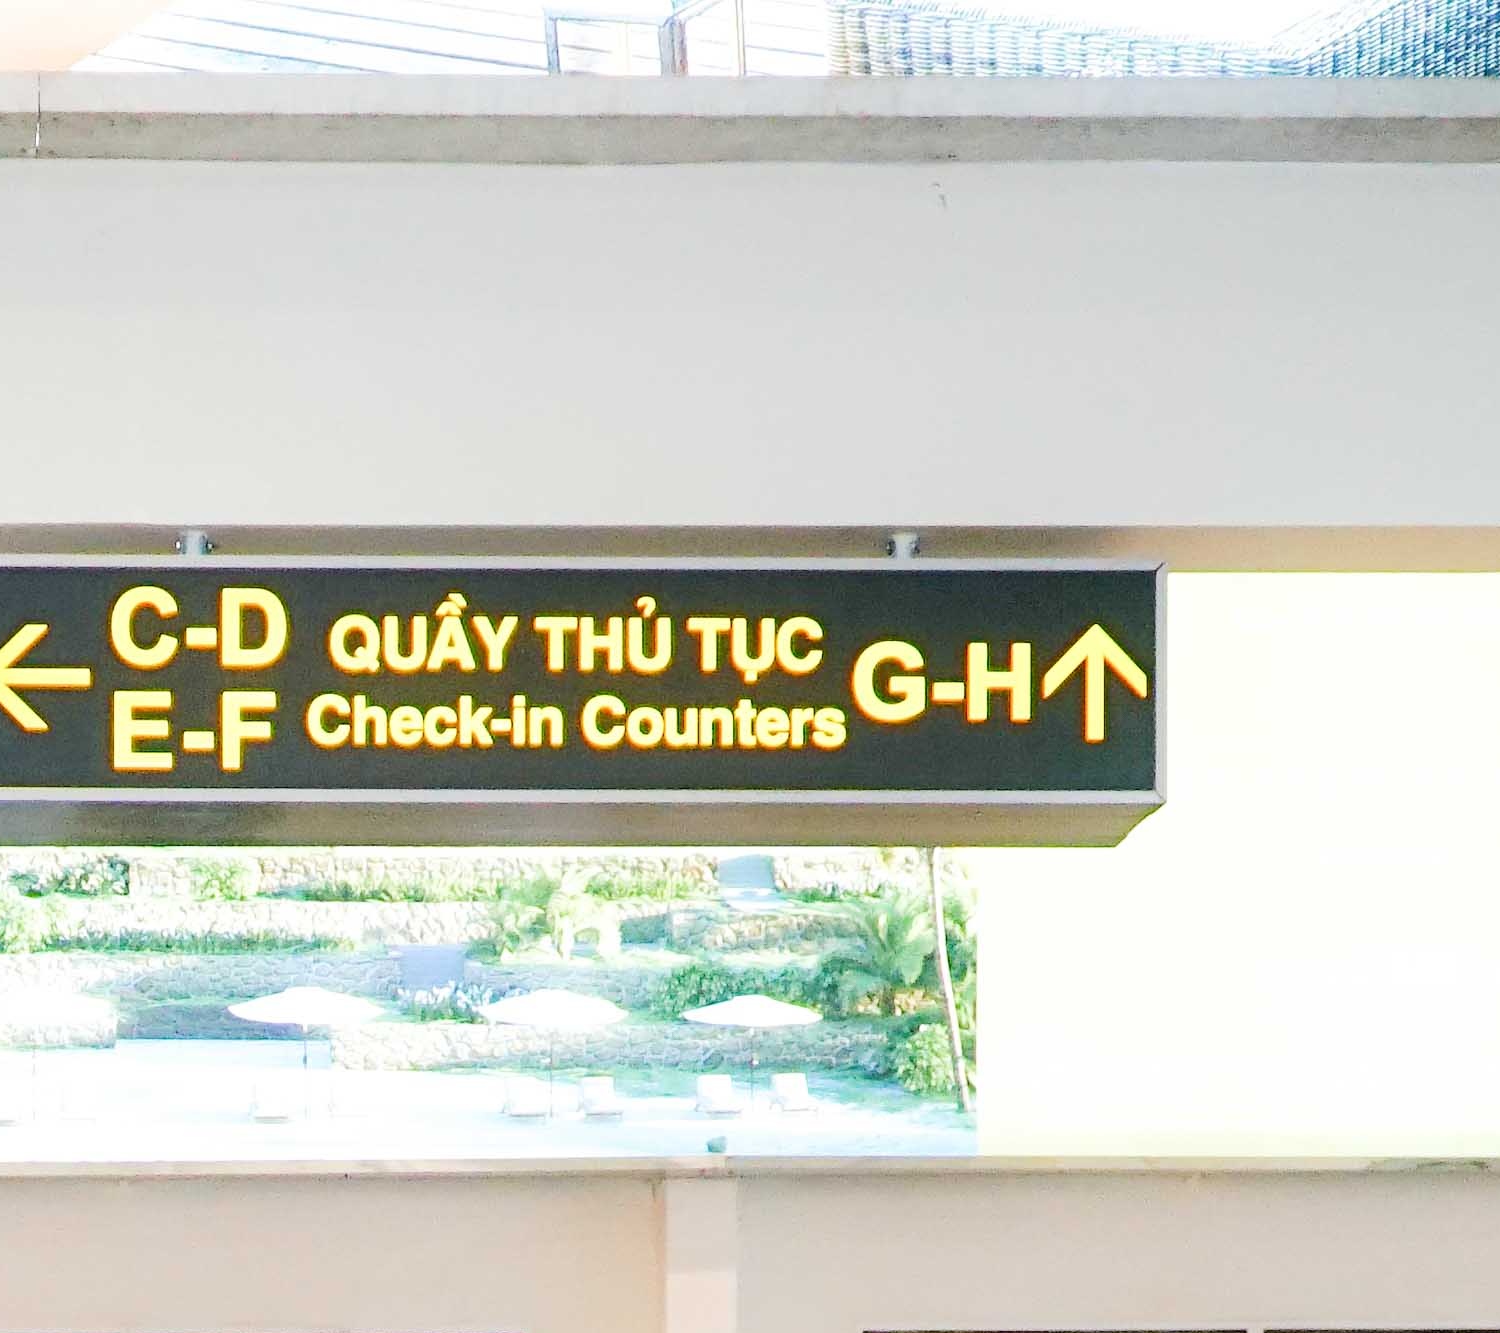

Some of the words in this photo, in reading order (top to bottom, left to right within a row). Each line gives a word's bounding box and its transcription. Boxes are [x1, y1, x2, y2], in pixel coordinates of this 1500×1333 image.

[109, 586, 290, 667] C-D
[328, 592, 519, 673] QUẦY
[533, 595, 673, 673] THỦ
[685, 613, 825, 684] TỤC
[849, 638, 1035, 724] G-H
[110, 690, 278, 772] E-F
[305, 694, 566, 749] Check-in
[580, 694, 848, 749] Counters
